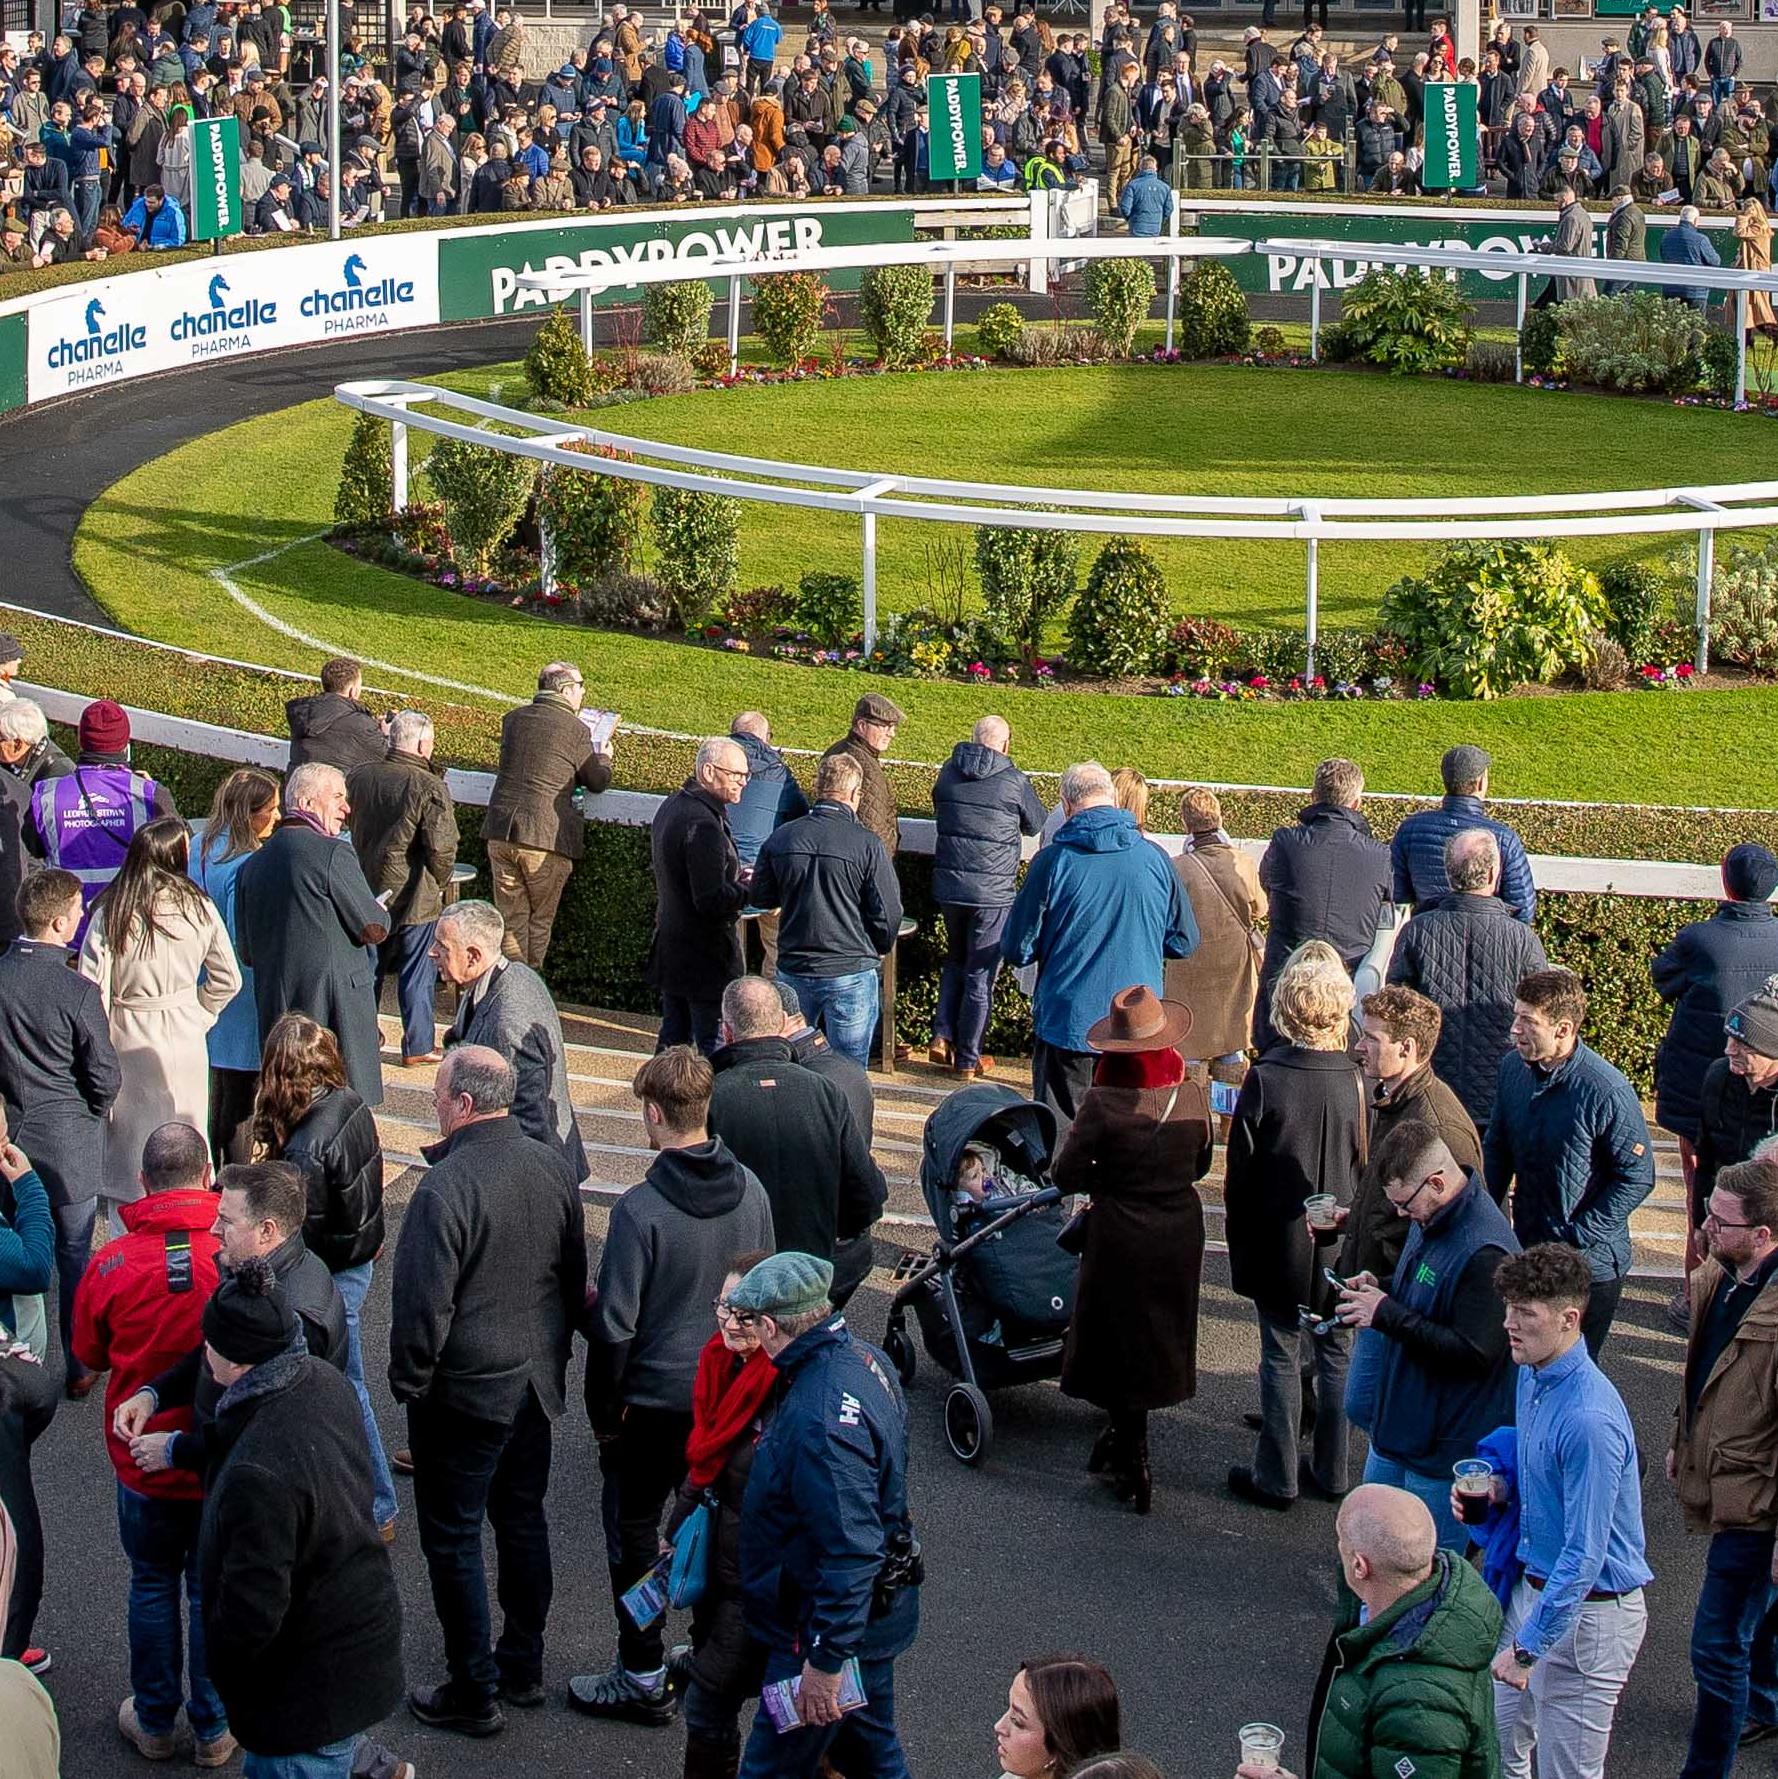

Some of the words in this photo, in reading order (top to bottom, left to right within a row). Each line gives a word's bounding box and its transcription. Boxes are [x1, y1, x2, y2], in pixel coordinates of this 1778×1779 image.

[300, 278, 415, 318] chanelle
[170, 299, 277, 342] chanelle
[324, 312, 390, 334] PHARMA
[47, 323, 147, 369] chanelle
[192, 333, 253, 359] PHARMA
[67, 359, 125, 387] PHARMA
